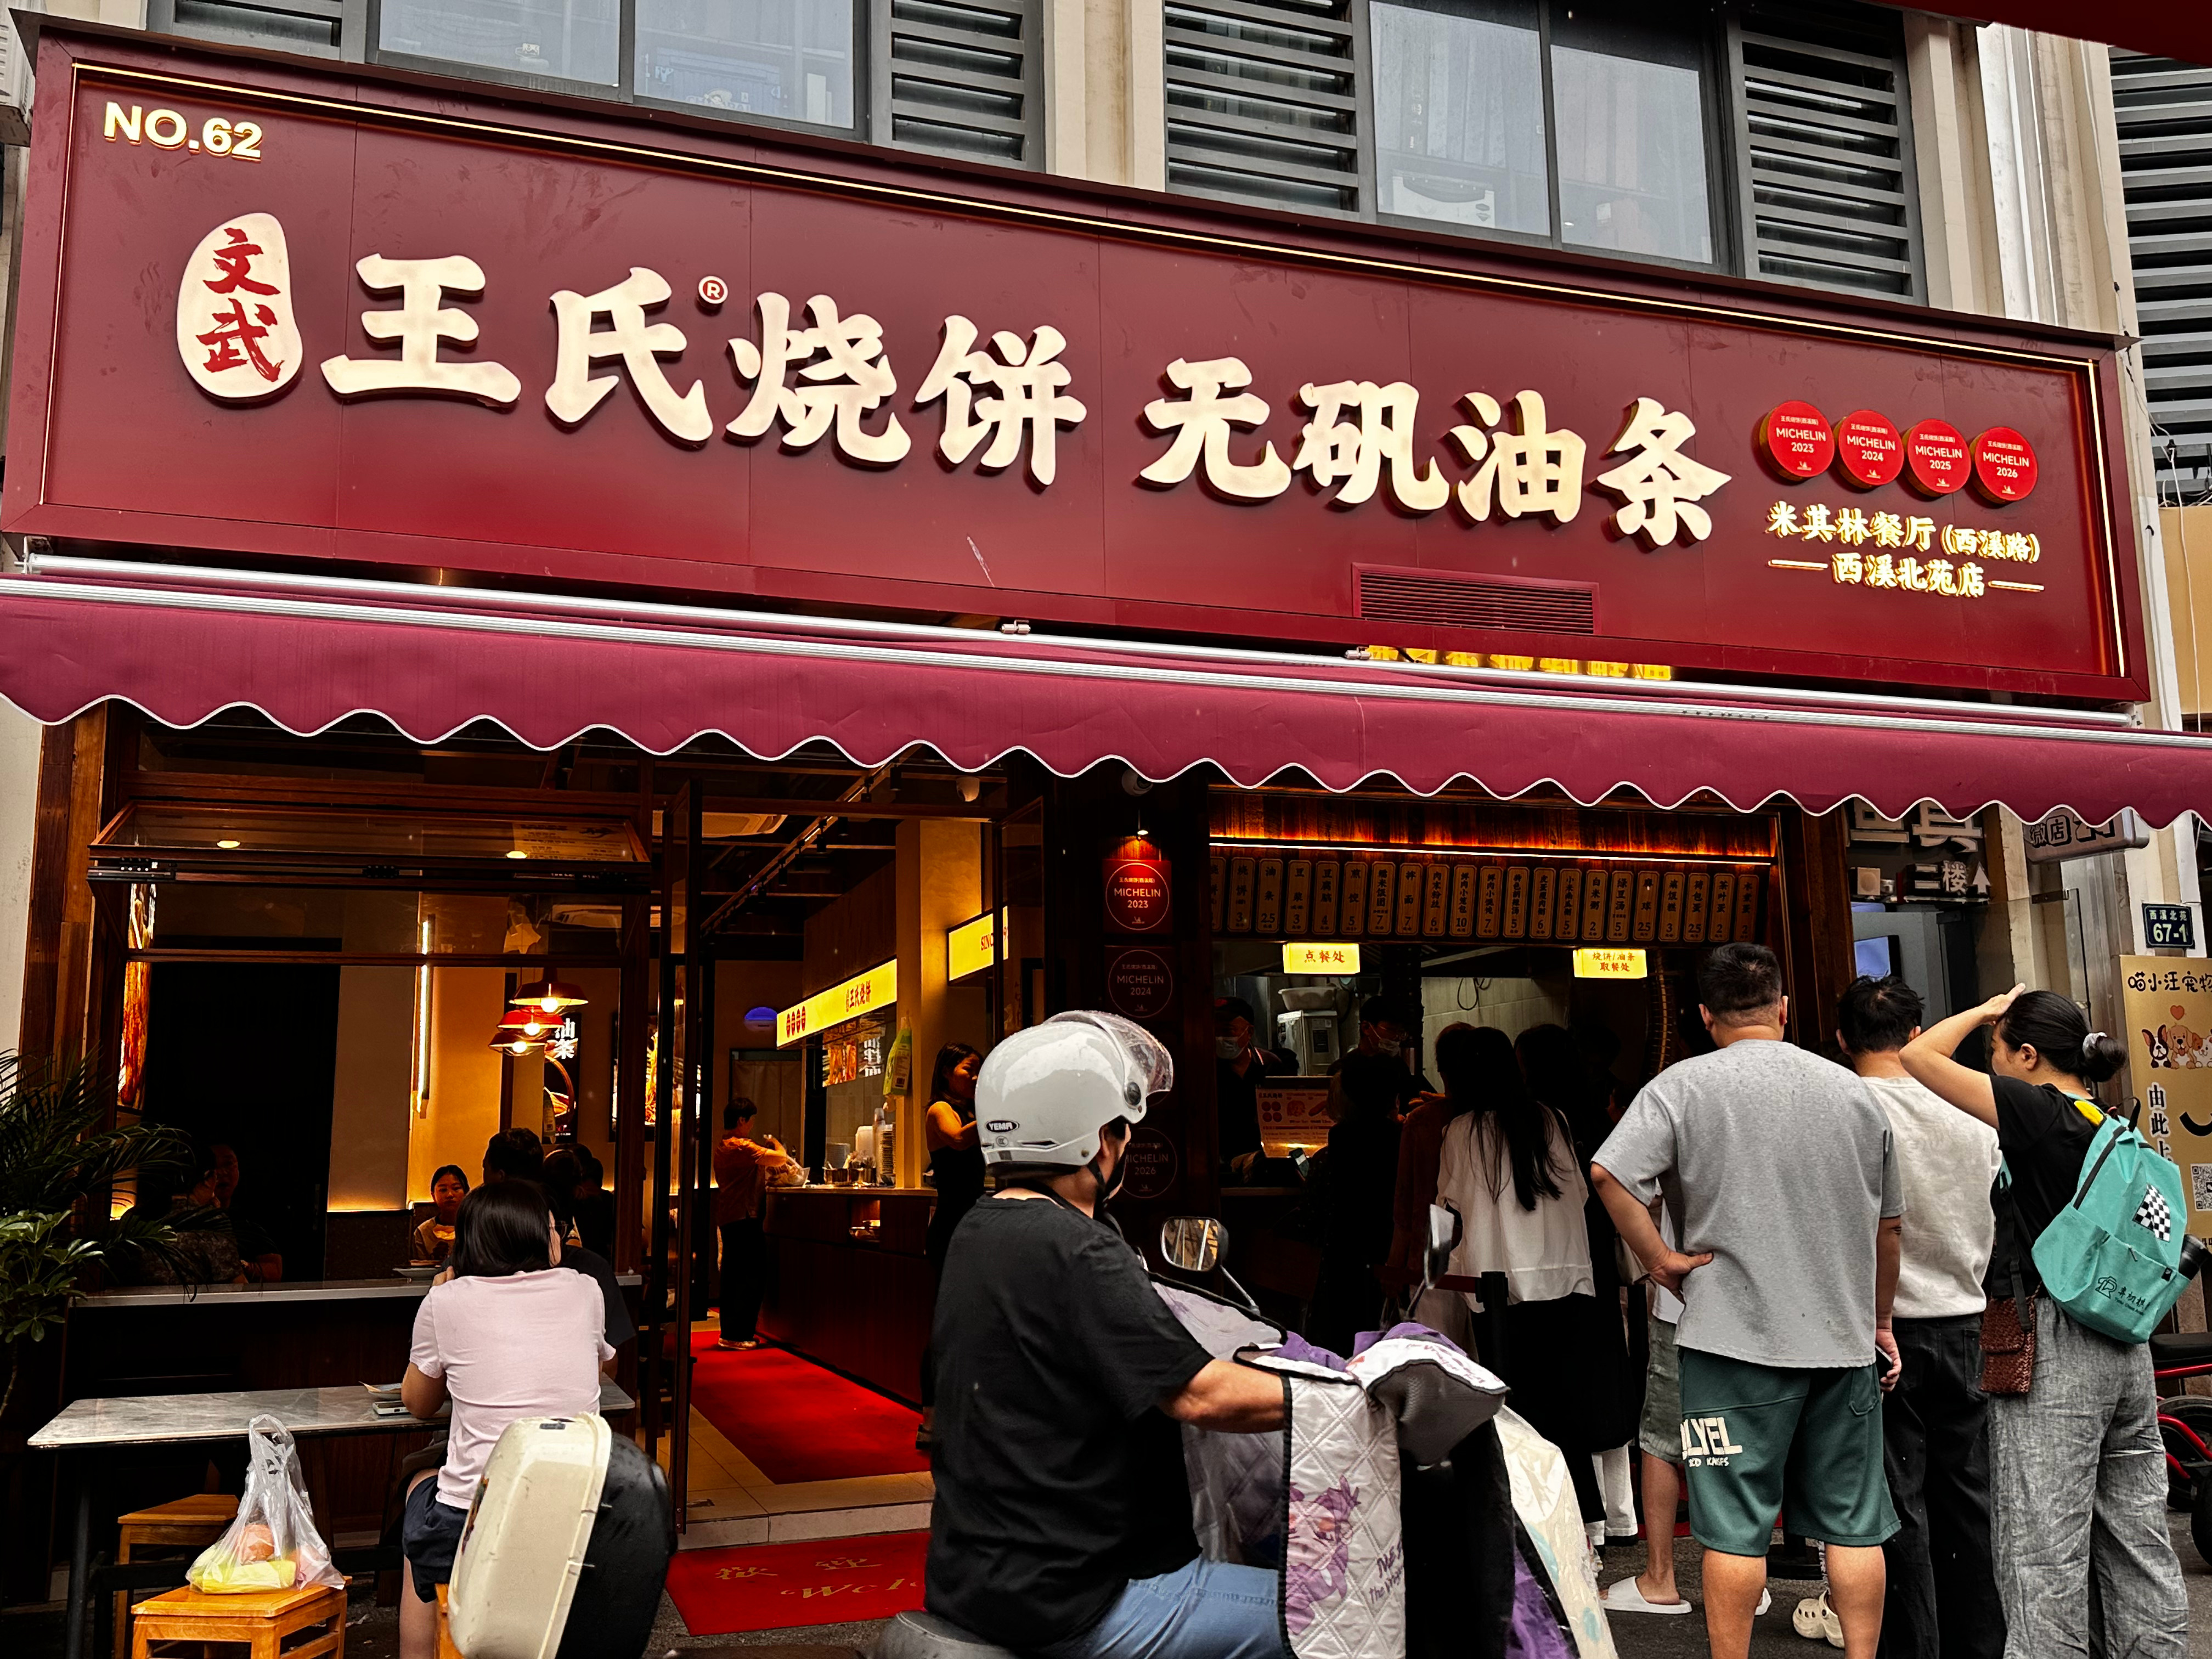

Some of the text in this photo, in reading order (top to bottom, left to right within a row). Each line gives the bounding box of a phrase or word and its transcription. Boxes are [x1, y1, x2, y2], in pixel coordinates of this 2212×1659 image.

[103, 100, 263, 160] NO.62
[195, 227, 281, 382] 文武
[320, 252, 1733, 548] 王氏烧饼 无矾油条
[1775, 427, 1826, 442] MICHELIN
[1791, 442, 1814, 453] 2023
[1846, 435, 1895, 450] MICHELIN
[1861, 450, 1884, 462] 2024
[1915, 445, 1963, 459] MICHELIN
[1982, 452, 2029, 467] MICHELIN
[1929, 460, 1952, 470] 2025
[1996, 467, 2018, 478] 2026
[1831, 552, 1986, 597] 西溪北苑店
[1914, 860, 1967, 896] 二楼
[1114, 888, 1161, 898] MICHELIN
[1127, 900, 1149, 909] 2023
[1236, 912, 1243, 922] 3
[1293, 914, 1300, 924] 3
[1322, 915, 1328, 925] 4
[1348, 916, 1355, 926] 5
[1377, 915, 1383, 925] 7
[2149, 910, 2187, 922] 西溪北苑
[1405, 917, 1411, 926] 7
[1431, 917, 1437, 926] 6
[1456, 917, 1467, 927] 10
[1485, 919, 1491, 928] 7
[1511, 919, 1517, 928] 5
[1538, 919, 1544, 929] 6
[1564, 921, 1570, 930] 5
[1590, 922, 1596, 931] 2
[1615, 922, 1621, 932] 5
[1667, 923, 1673, 933] 3
[1717, 923, 1723, 933] 2
[1742, 925, 1748, 934] 2
[2153, 923, 2187, 943] 67-1
[1304, 950, 1345, 963] 点餐处
[1599, 962, 1630, 972] 取餐处
[1116, 975, 1164, 984] MICHELIN
[1130, 987, 1152, 996] 2024
[989, 1121, 1013, 1131] YEMA
[1134, 1166, 1156, 1175] 2026
